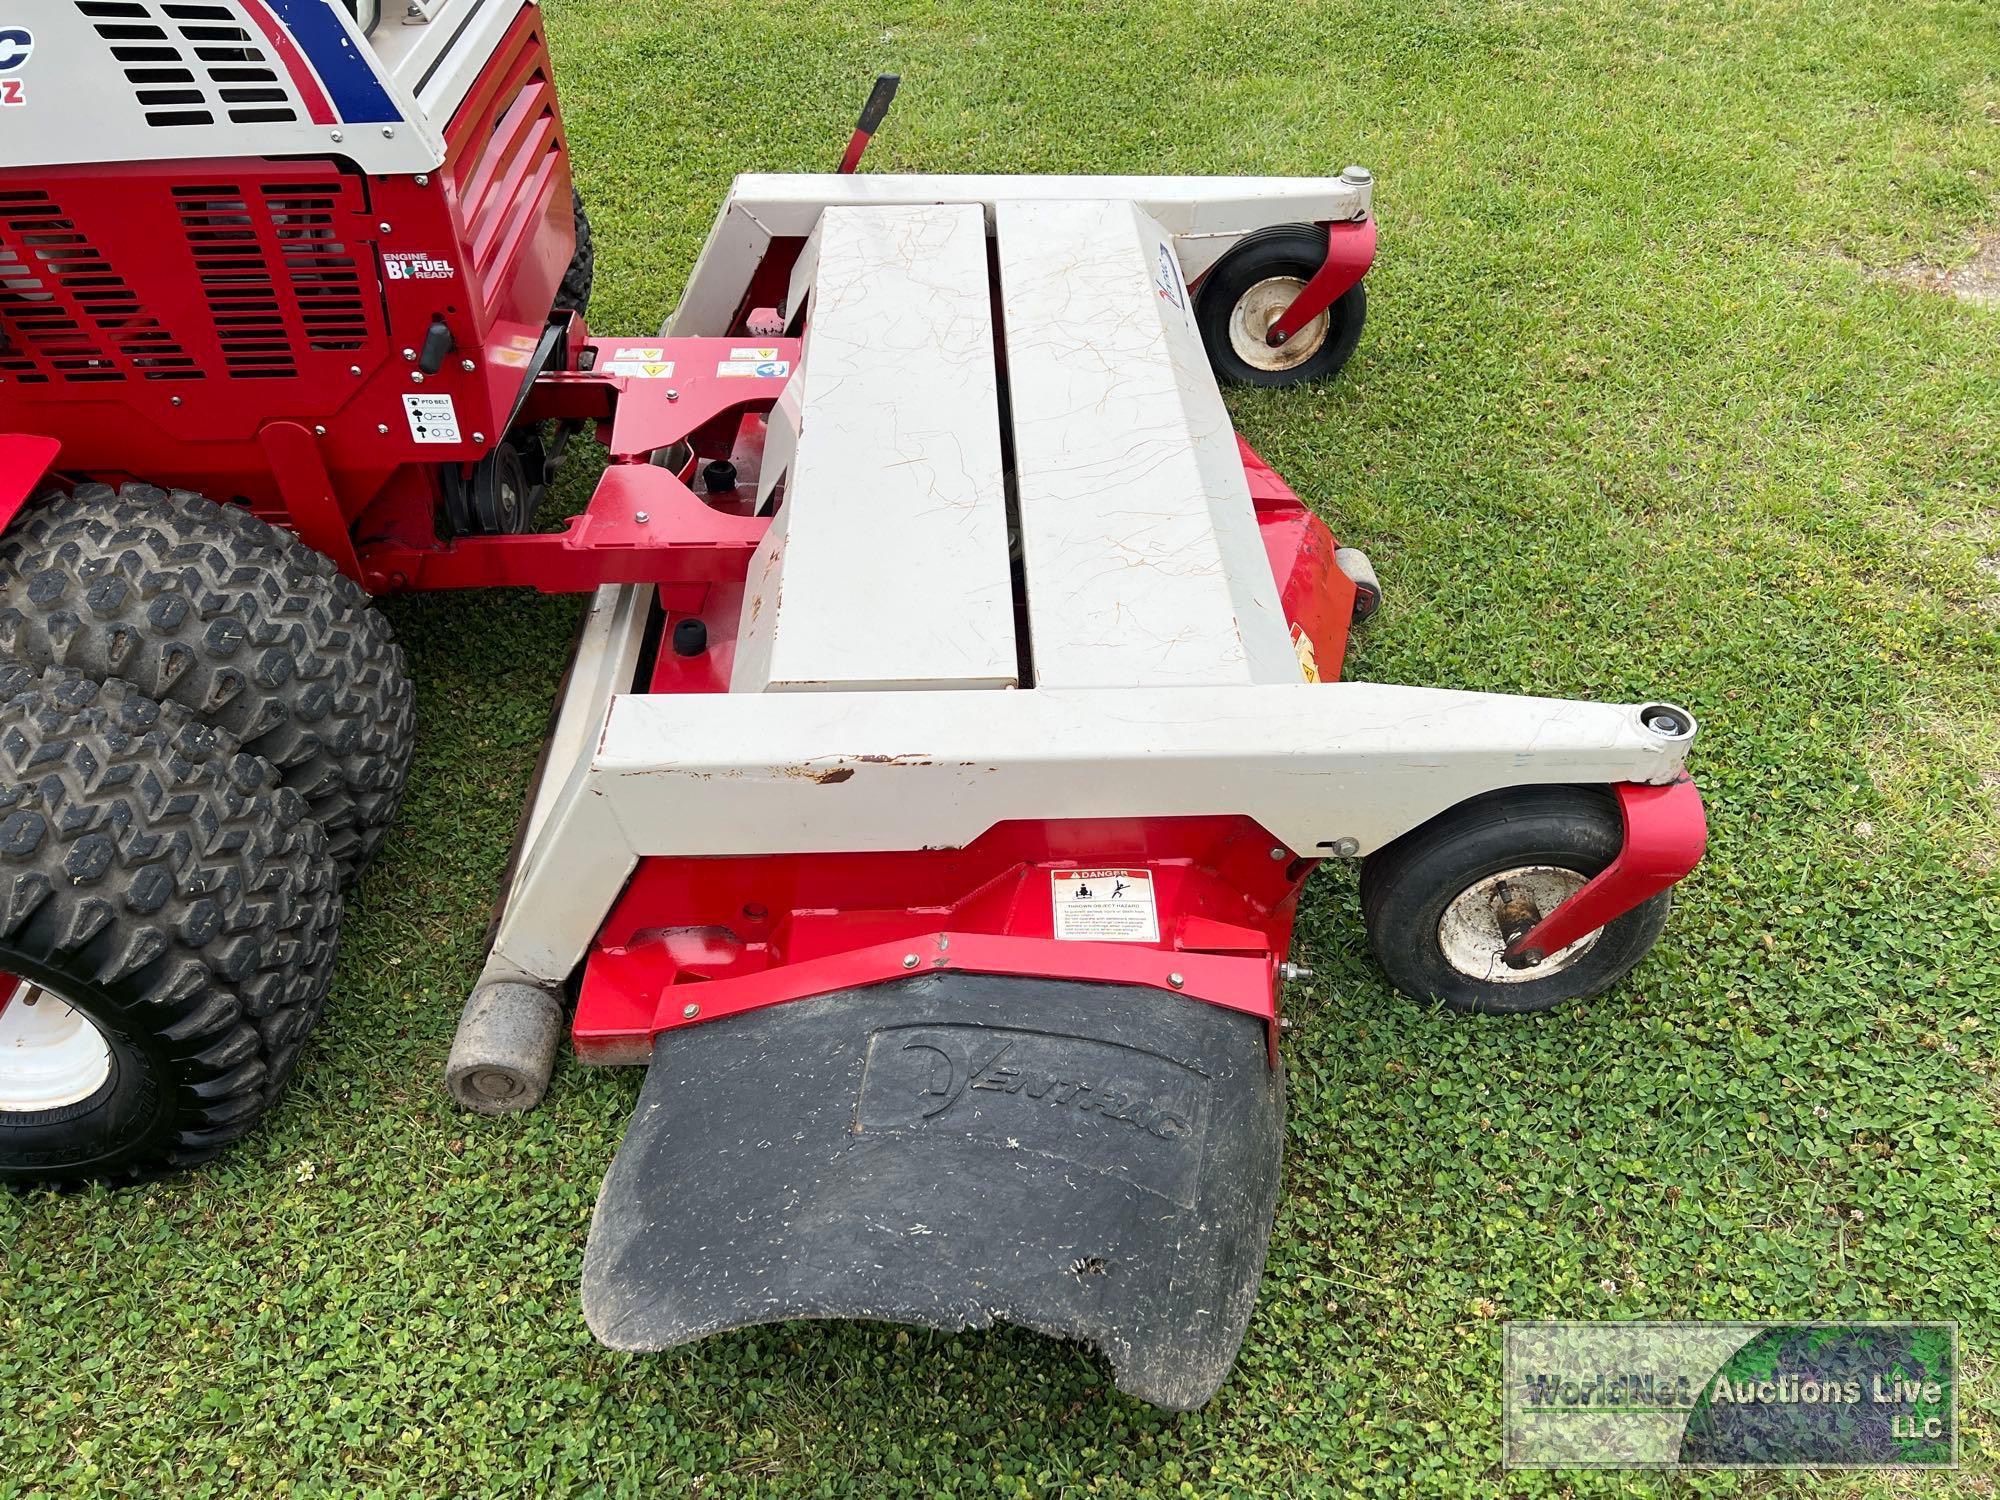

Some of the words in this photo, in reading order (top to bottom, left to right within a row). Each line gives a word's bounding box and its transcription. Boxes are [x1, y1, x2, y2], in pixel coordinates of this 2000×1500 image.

[382, 253, 428, 261] ENGINE
[412, 260, 454, 272] FUEL
[415, 271, 455, 279] READY
[1081, 870, 1129, 878] DANGER
